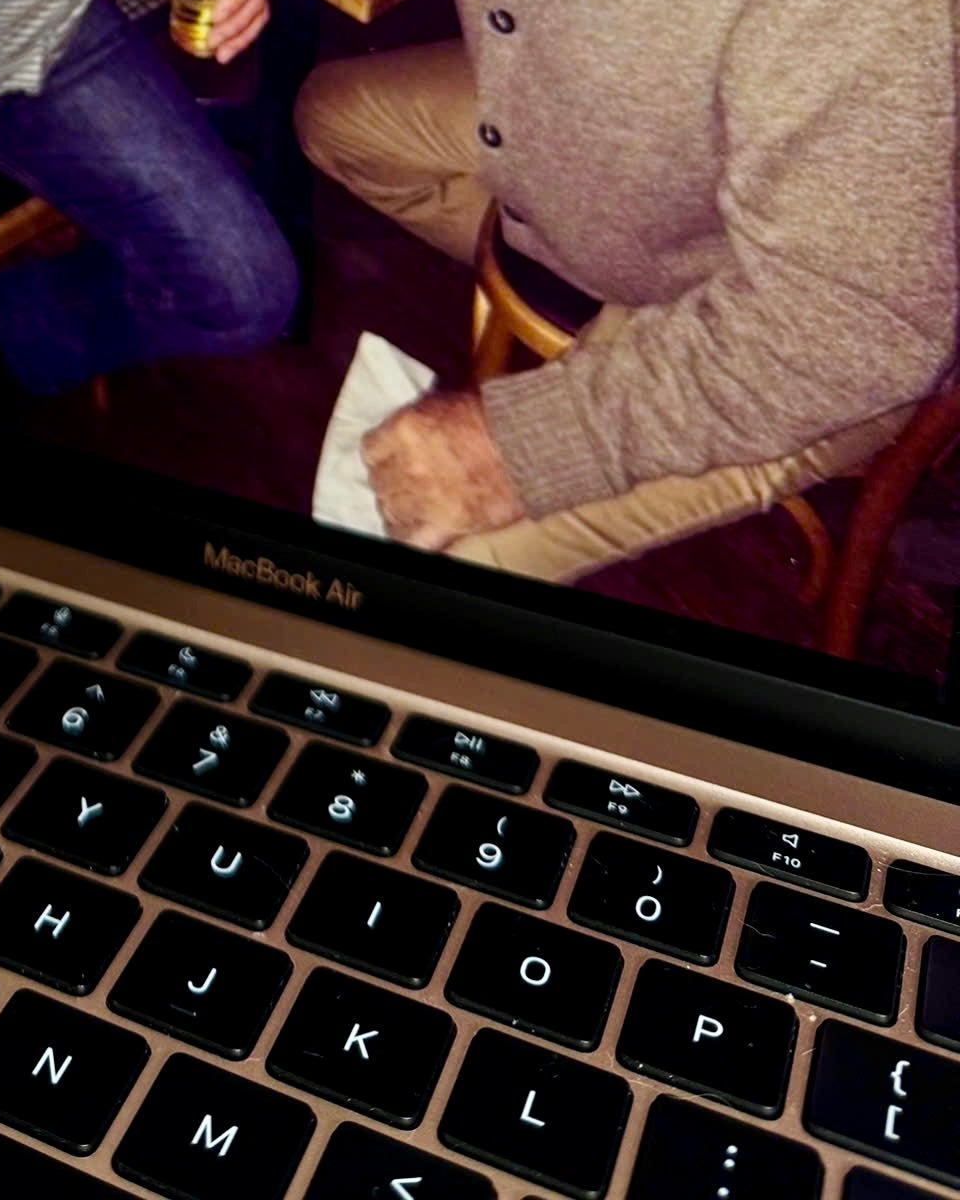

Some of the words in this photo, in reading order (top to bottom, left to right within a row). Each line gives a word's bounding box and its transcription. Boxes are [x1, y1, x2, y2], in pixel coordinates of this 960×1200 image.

[204, 541, 321, 600] MacBook
[326, 577, 364, 611] Air
[61, 706, 89, 735] 6
[192, 748, 218, 775] 7
[77, 796, 103, 827] Y
[327, 794, 356, 822] 8
[210, 845, 243, 878] U
[475, 842, 502, 870] 9
[771, 851, 802, 869] F10
[33, 903, 71, 939] H
[187, 967, 217, 995] J
[519, 956, 552, 987] O
[343, 1022, 380, 1060] K
[692, 1014, 725, 1043] P
[31, 1046, 73, 1086] N
[519, 1089, 546, 1127] L
[190, 1113, 239, 1157] M
